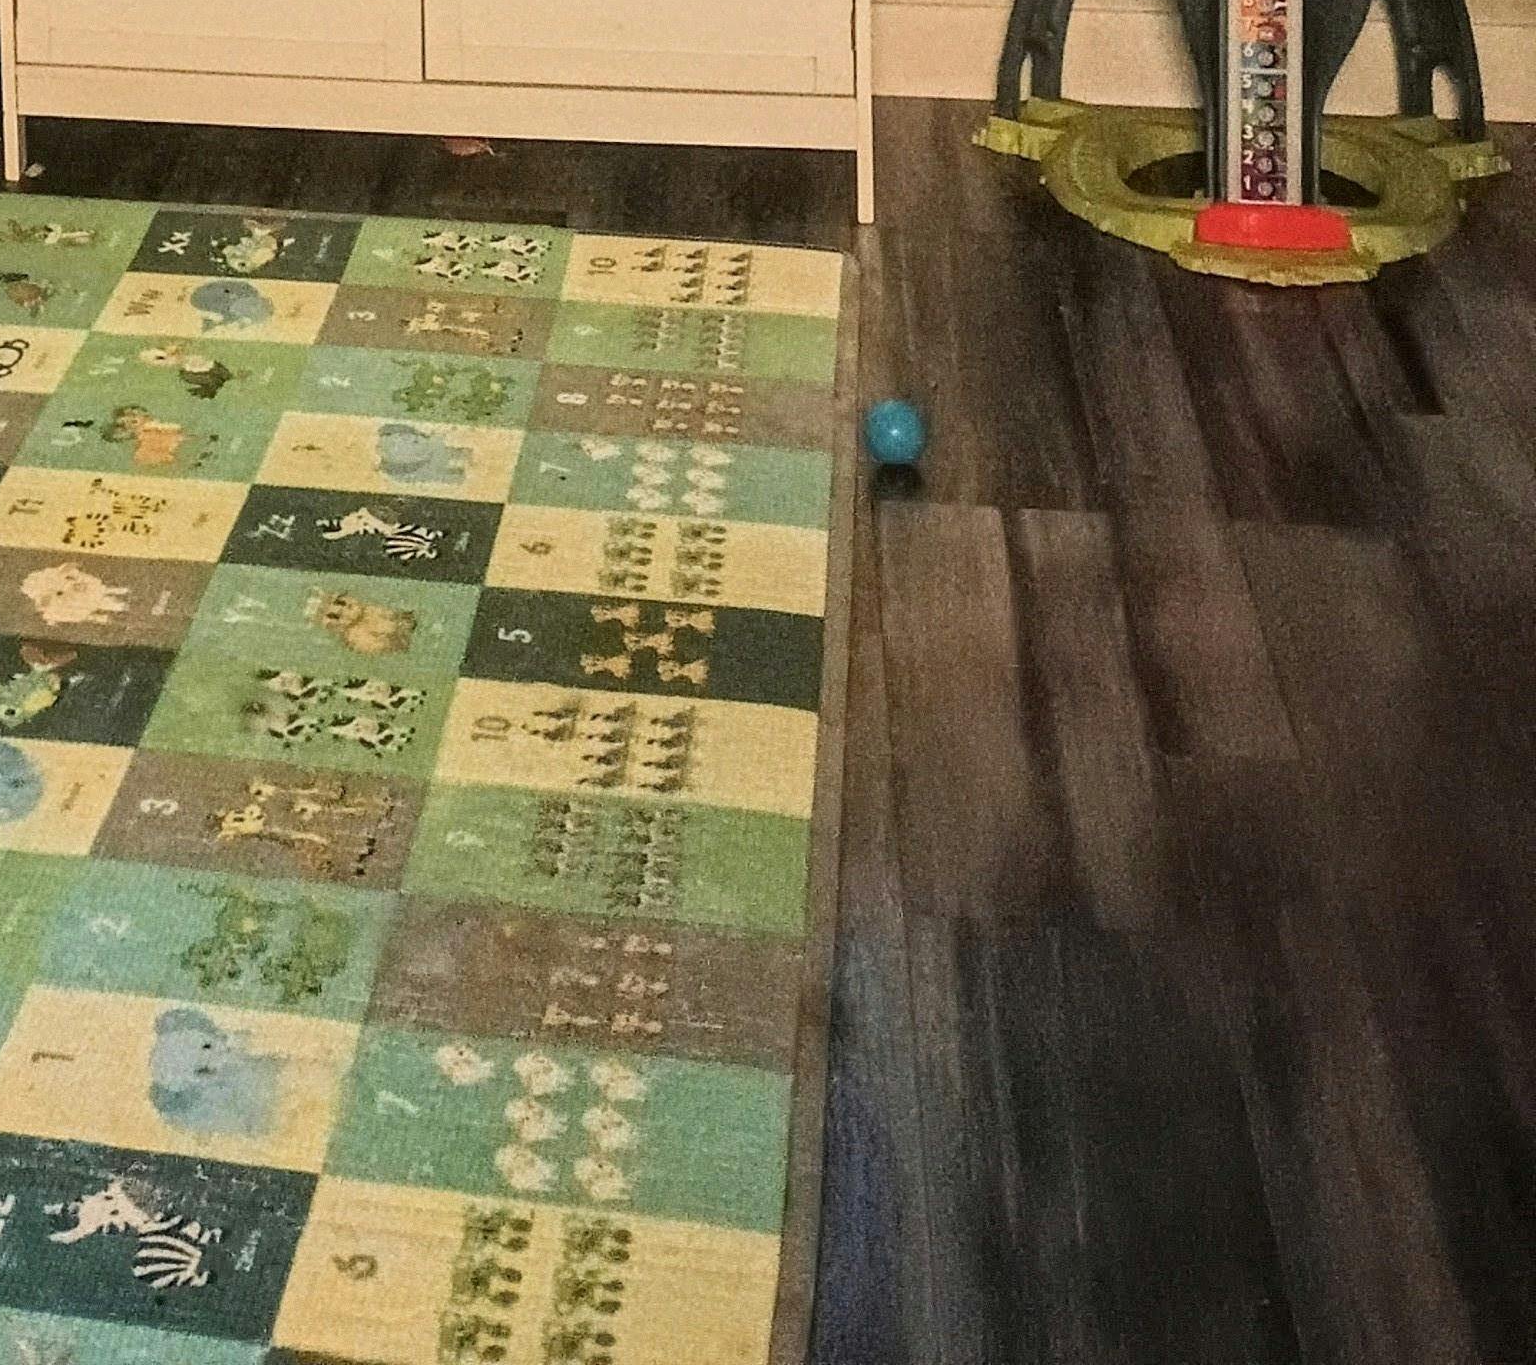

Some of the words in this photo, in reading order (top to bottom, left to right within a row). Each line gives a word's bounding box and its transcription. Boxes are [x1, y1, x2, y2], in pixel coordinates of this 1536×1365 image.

[1243, 43, 1254, 58] 6
[1242, 73, 1252, 89] 5
[1243, 125, 1254, 140] 3
[1243, 150, 1254, 165] 2
[1243, 175, 1252, 191] 1
[588, 256, 617, 275] 10
[497, 627, 532, 644] 5
[471, 715, 513, 742] 10
[332, 1253, 378, 1280] 6
